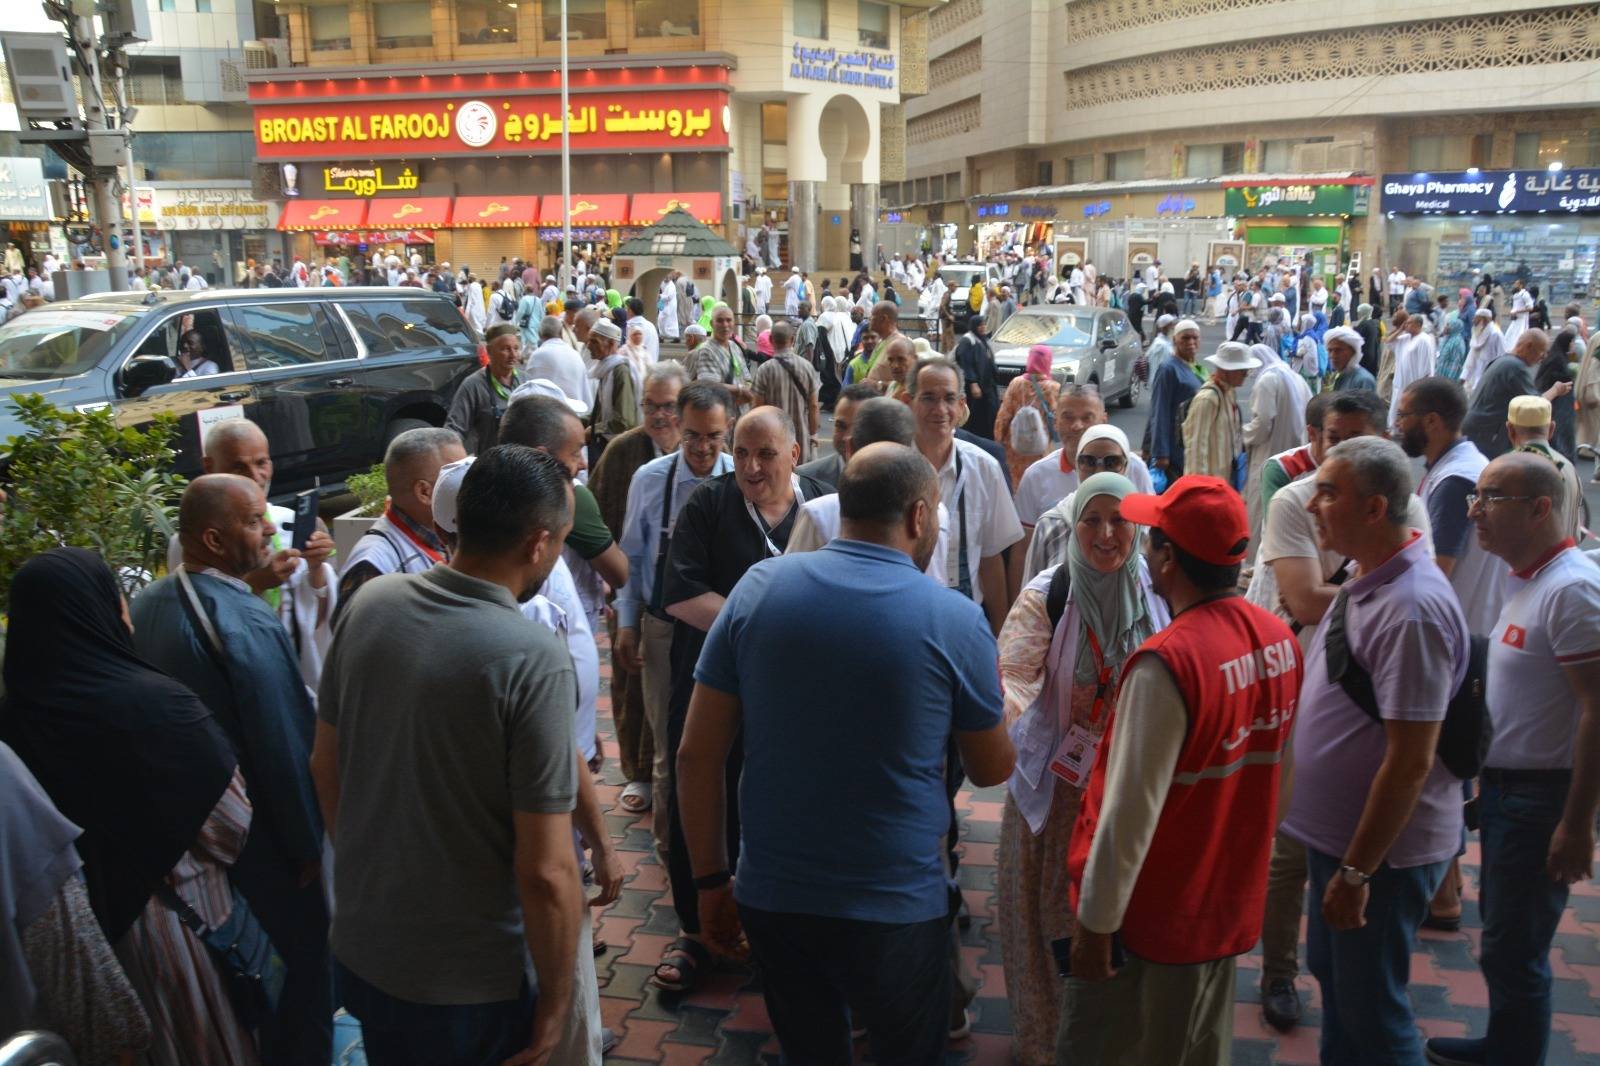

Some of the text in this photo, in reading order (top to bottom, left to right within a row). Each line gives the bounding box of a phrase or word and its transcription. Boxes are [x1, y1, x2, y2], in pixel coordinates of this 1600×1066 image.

[260, 104, 454, 143] BROAST AL FAROOJ
[605, 104, 711, 137] بروست
[324, 168, 418, 196] شاورما
[1384, 181, 1494, 196] Ghaya Pharmacy
[1525, 174, 1573, 196] غاية
[1415, 199, 1450, 209] Medical
